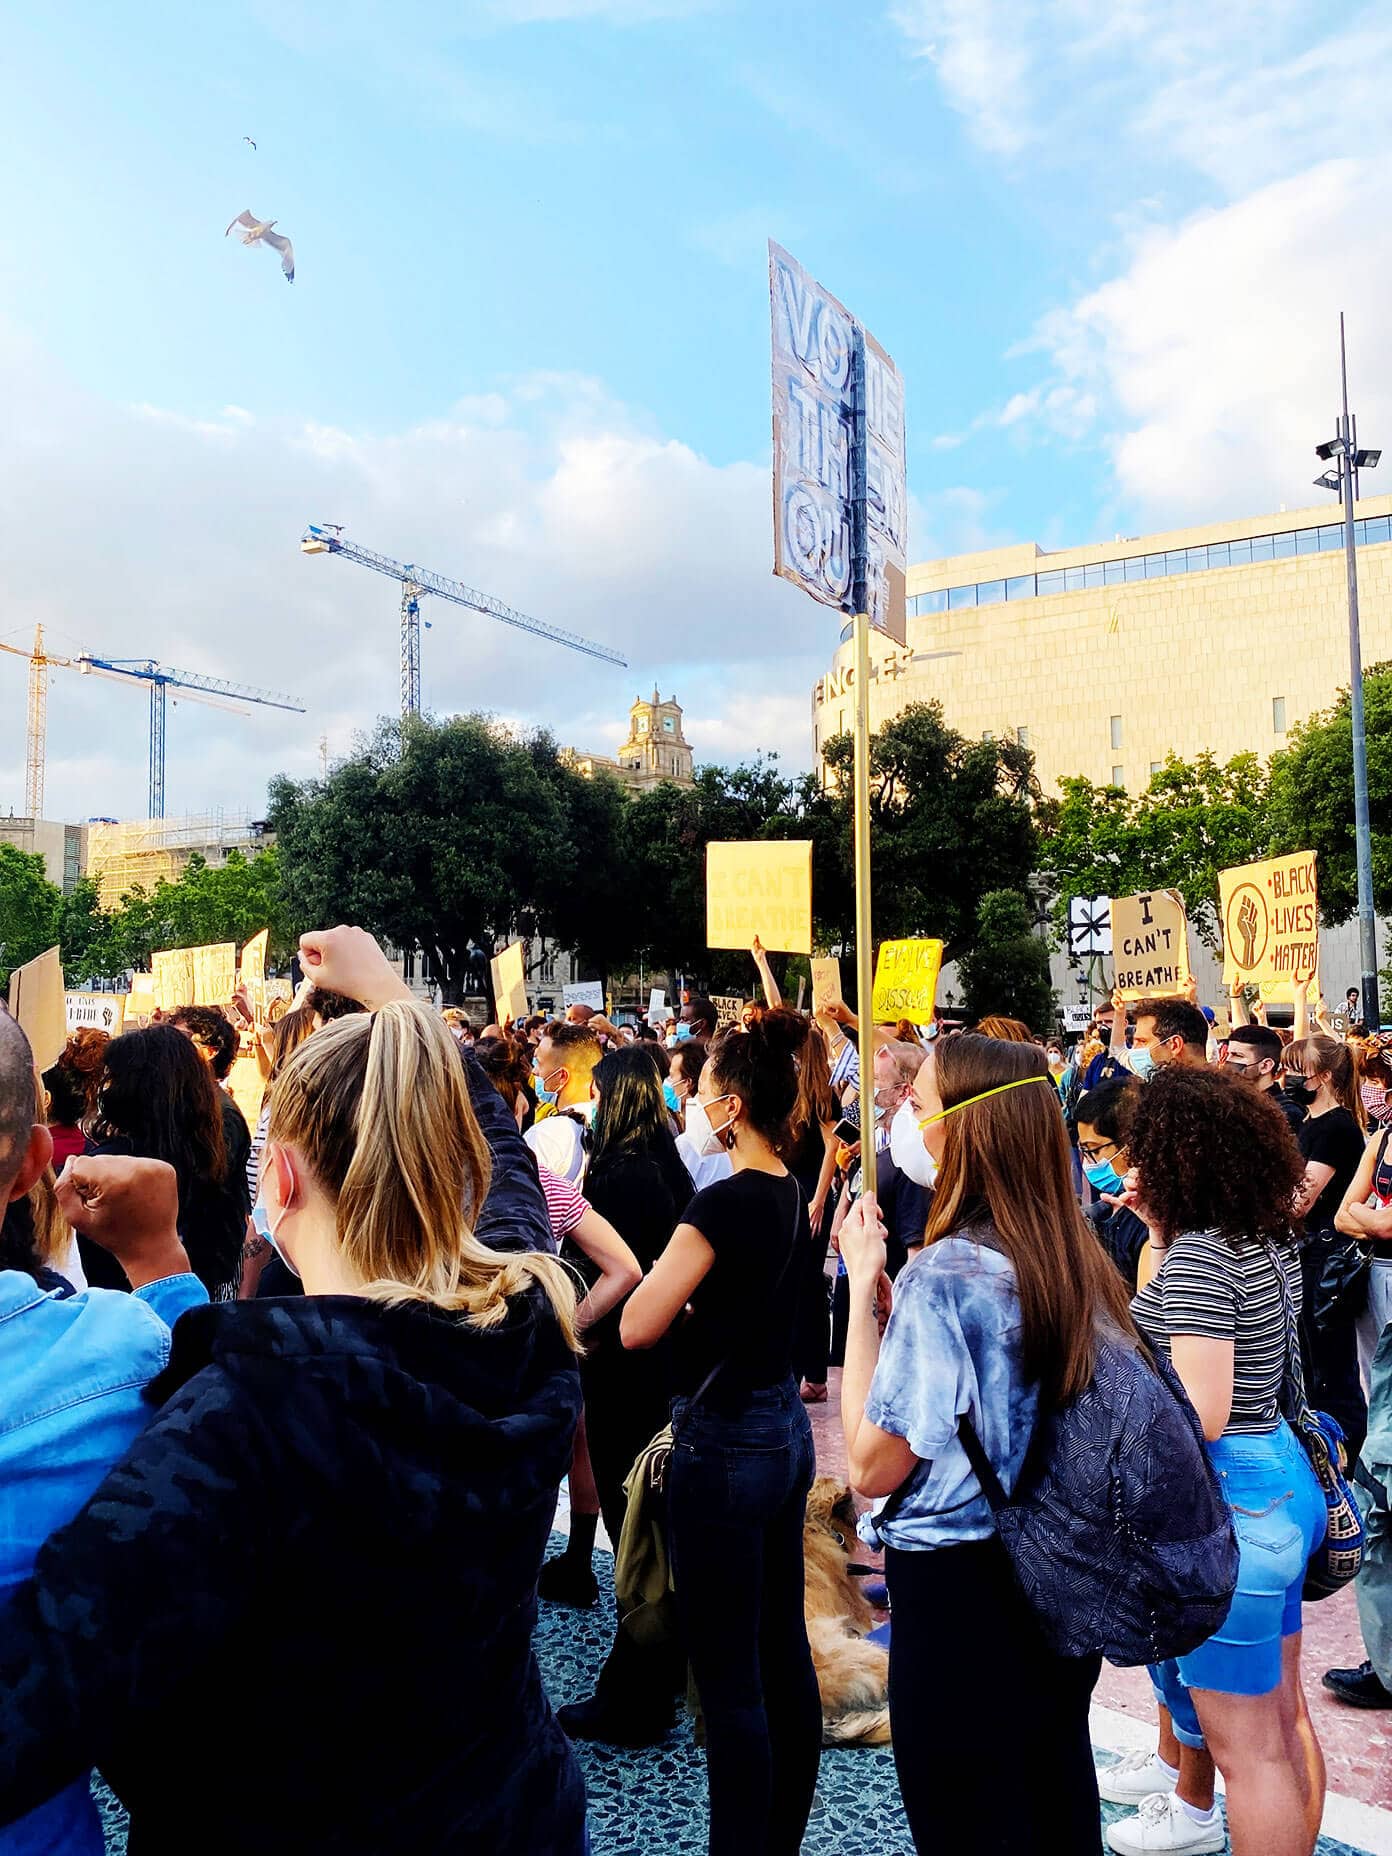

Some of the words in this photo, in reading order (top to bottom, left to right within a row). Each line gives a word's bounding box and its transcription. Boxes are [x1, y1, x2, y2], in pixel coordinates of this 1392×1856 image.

[1273, 863, 1314, 898] BLACK
[1138, 896, 1154, 925] I
[1275, 904, 1314, 935] LIVES
[1122, 928, 1172, 957] CAN'T
[1274, 942, 1316, 972] MATTER
[1118, 965, 1183, 989] BREATHE
